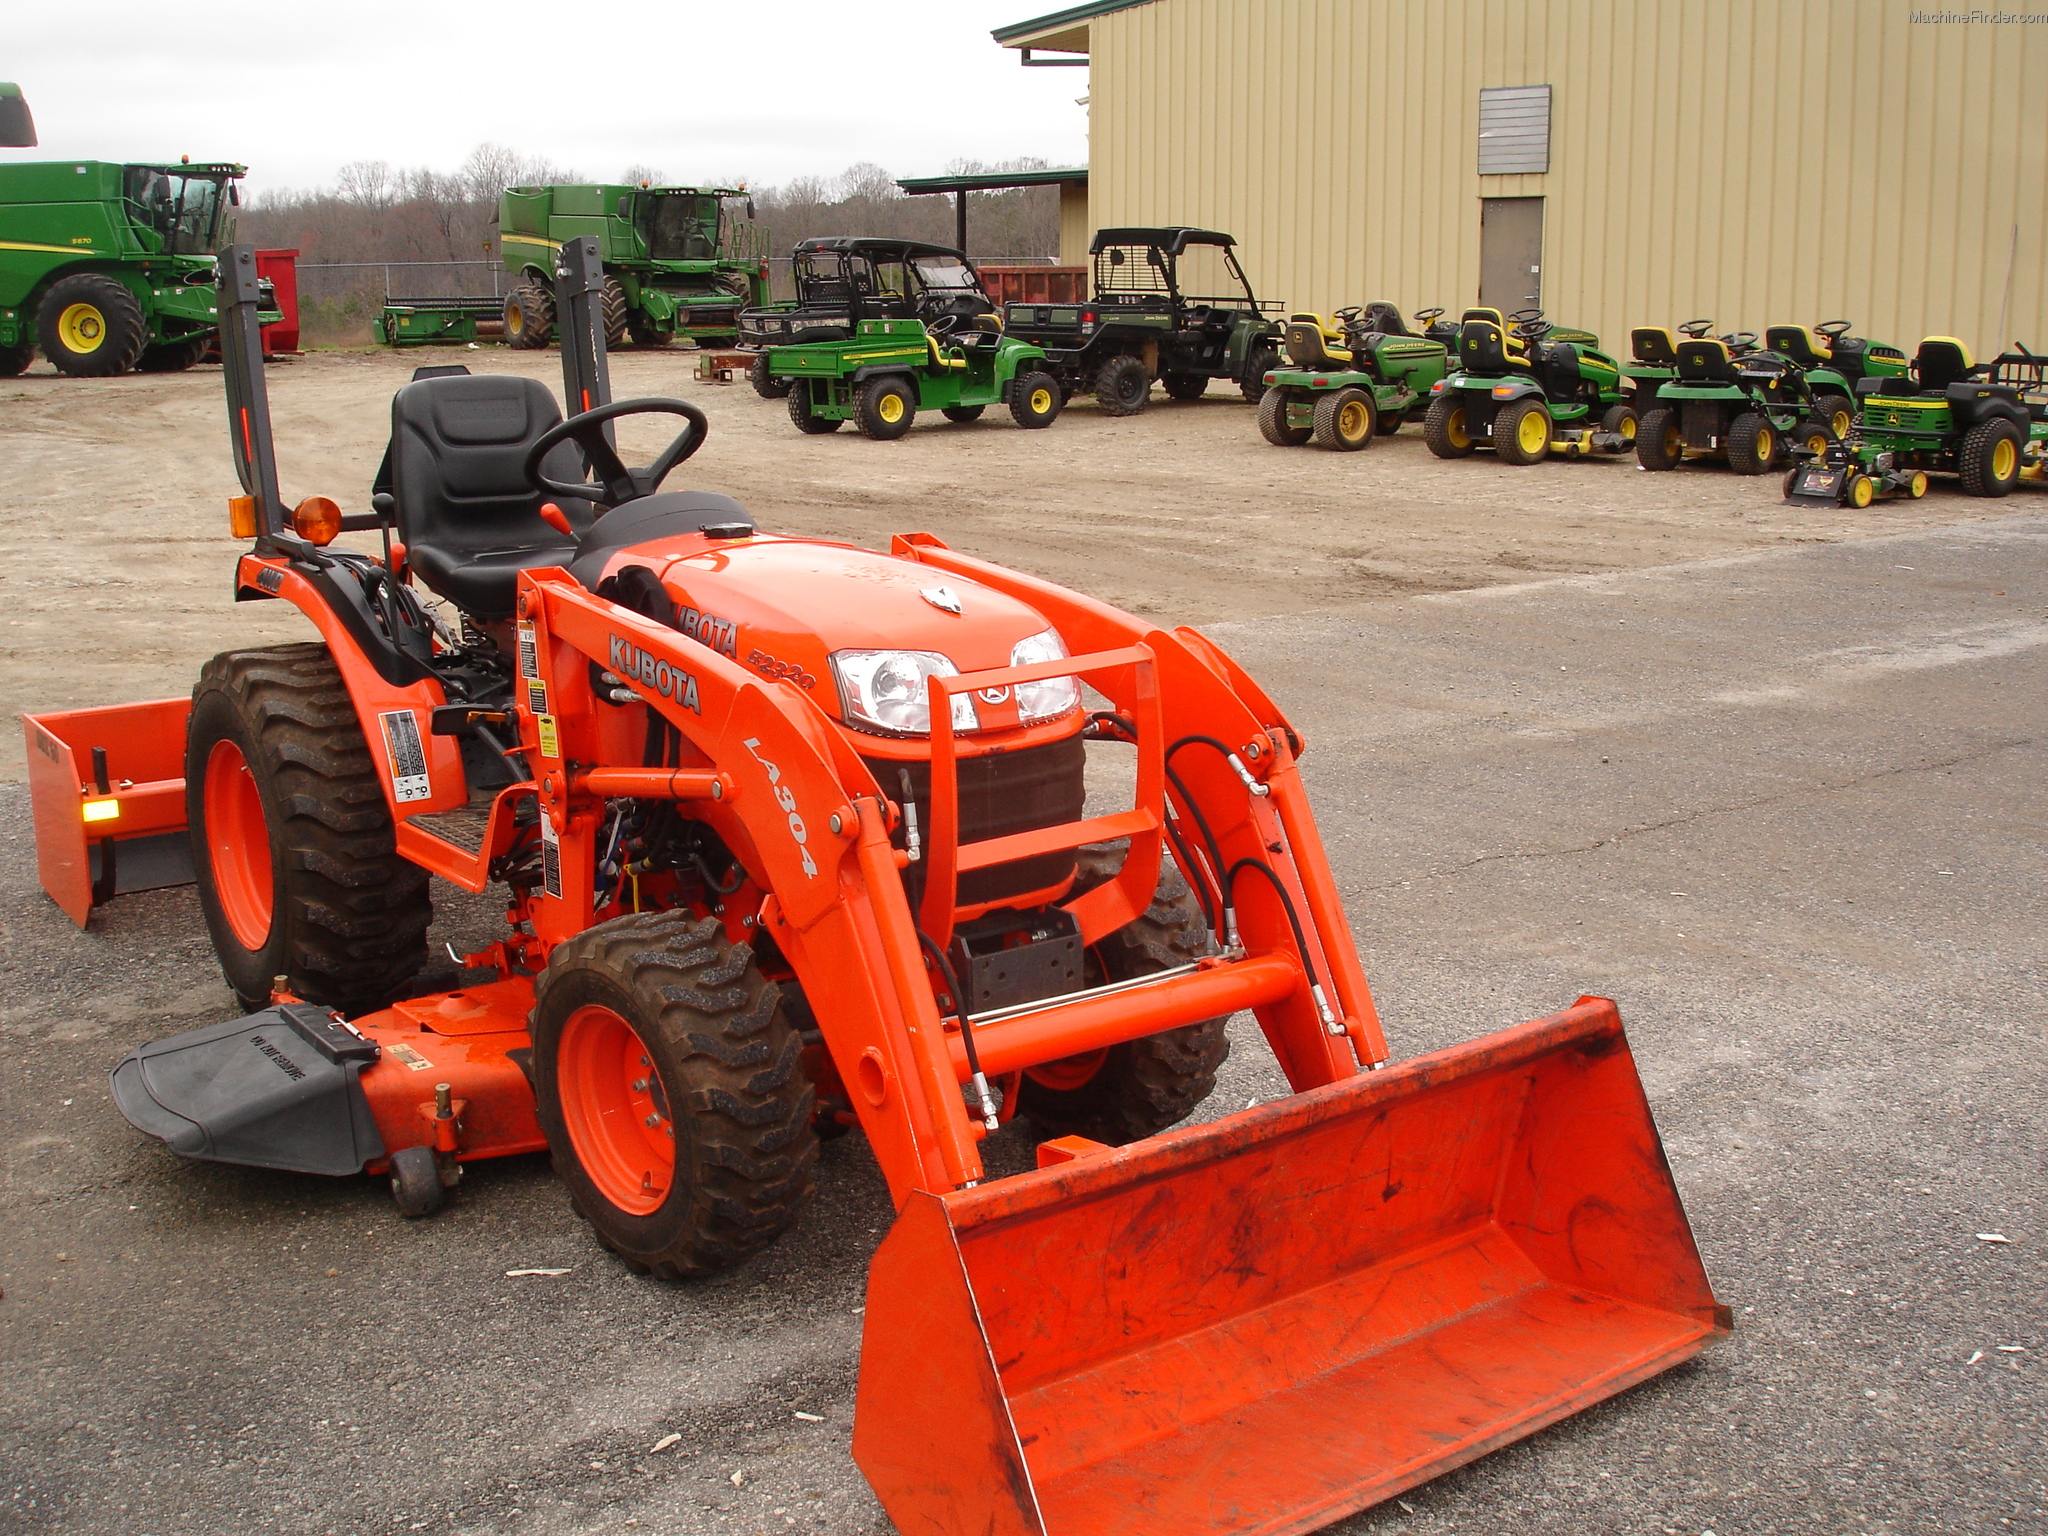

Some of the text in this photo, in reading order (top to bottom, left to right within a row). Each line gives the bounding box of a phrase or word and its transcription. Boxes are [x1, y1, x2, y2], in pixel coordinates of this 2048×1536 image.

[256, 566, 285, 593] 4WD
[609, 633, 701, 716] KUBOTA
[742, 737, 818, 880] LA304
[250, 1035, 306, 1081] DO NOT REMOVE
